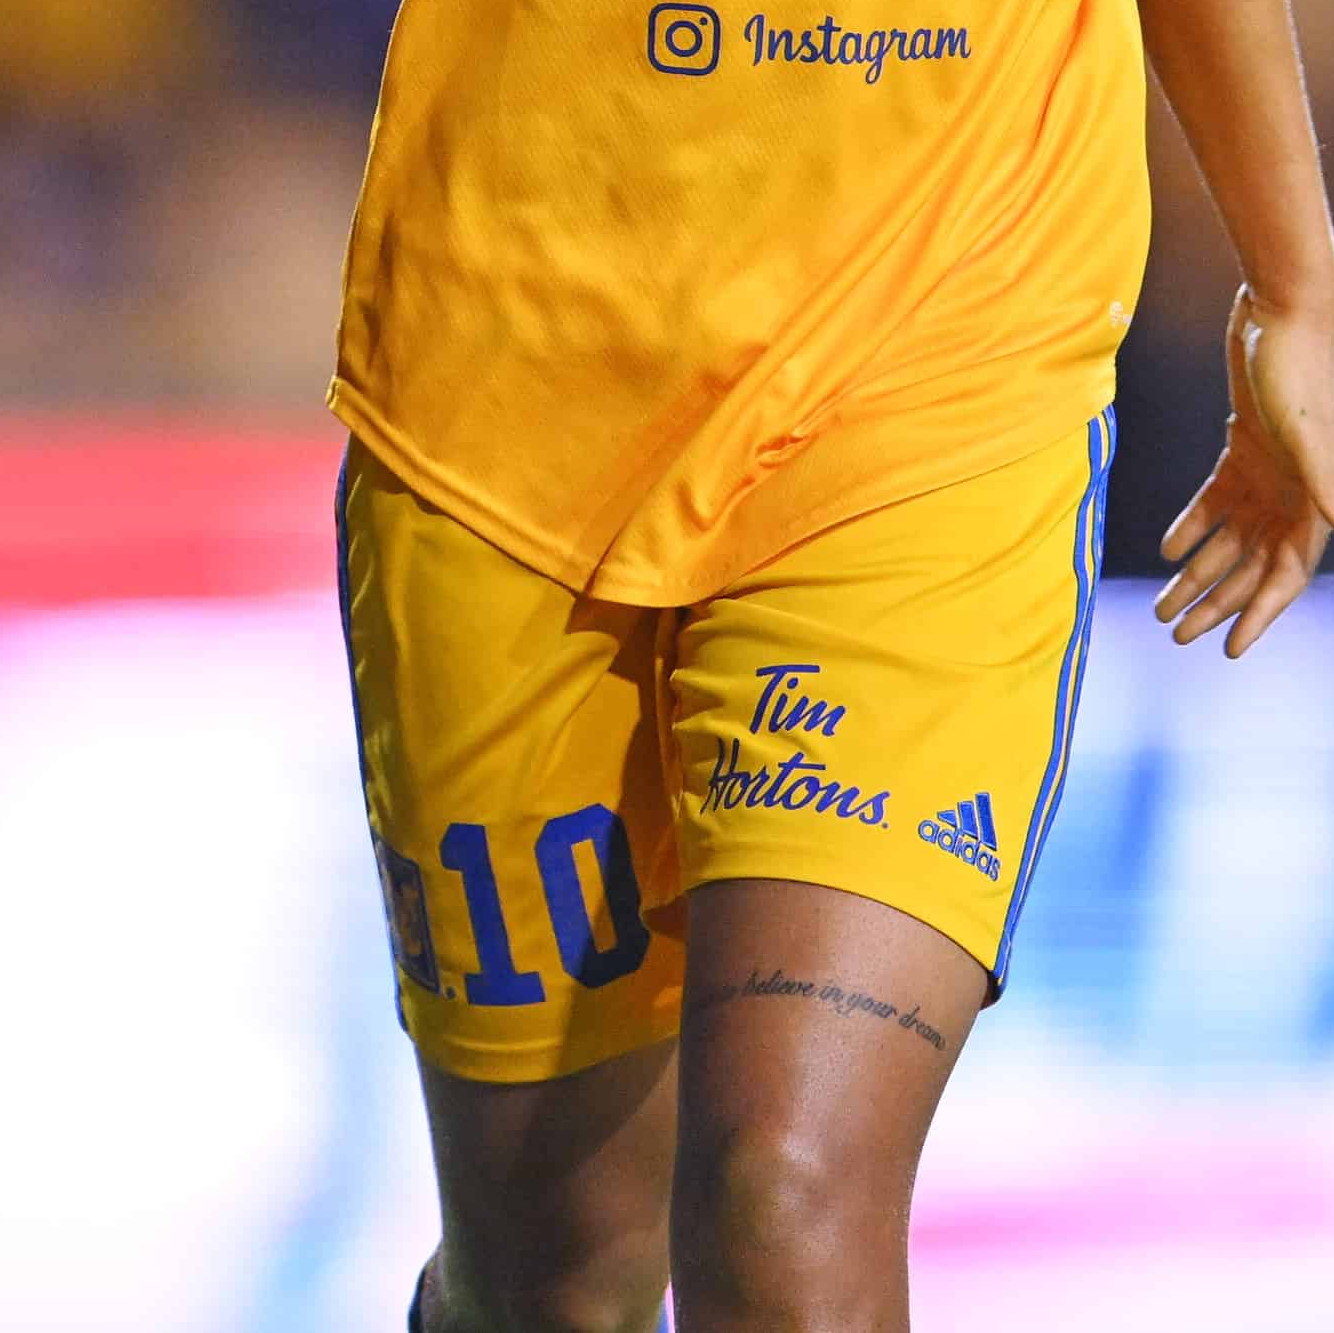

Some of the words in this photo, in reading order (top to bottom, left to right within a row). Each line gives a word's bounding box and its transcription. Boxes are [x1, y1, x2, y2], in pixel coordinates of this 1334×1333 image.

[743, 13, 972, 85] Instagram
[749, 664, 847, 738] Tim
[917, 818, 1002, 883] adidas
[439, 802, 652, 1007] 10
[819, 980, 844, 1003] in
